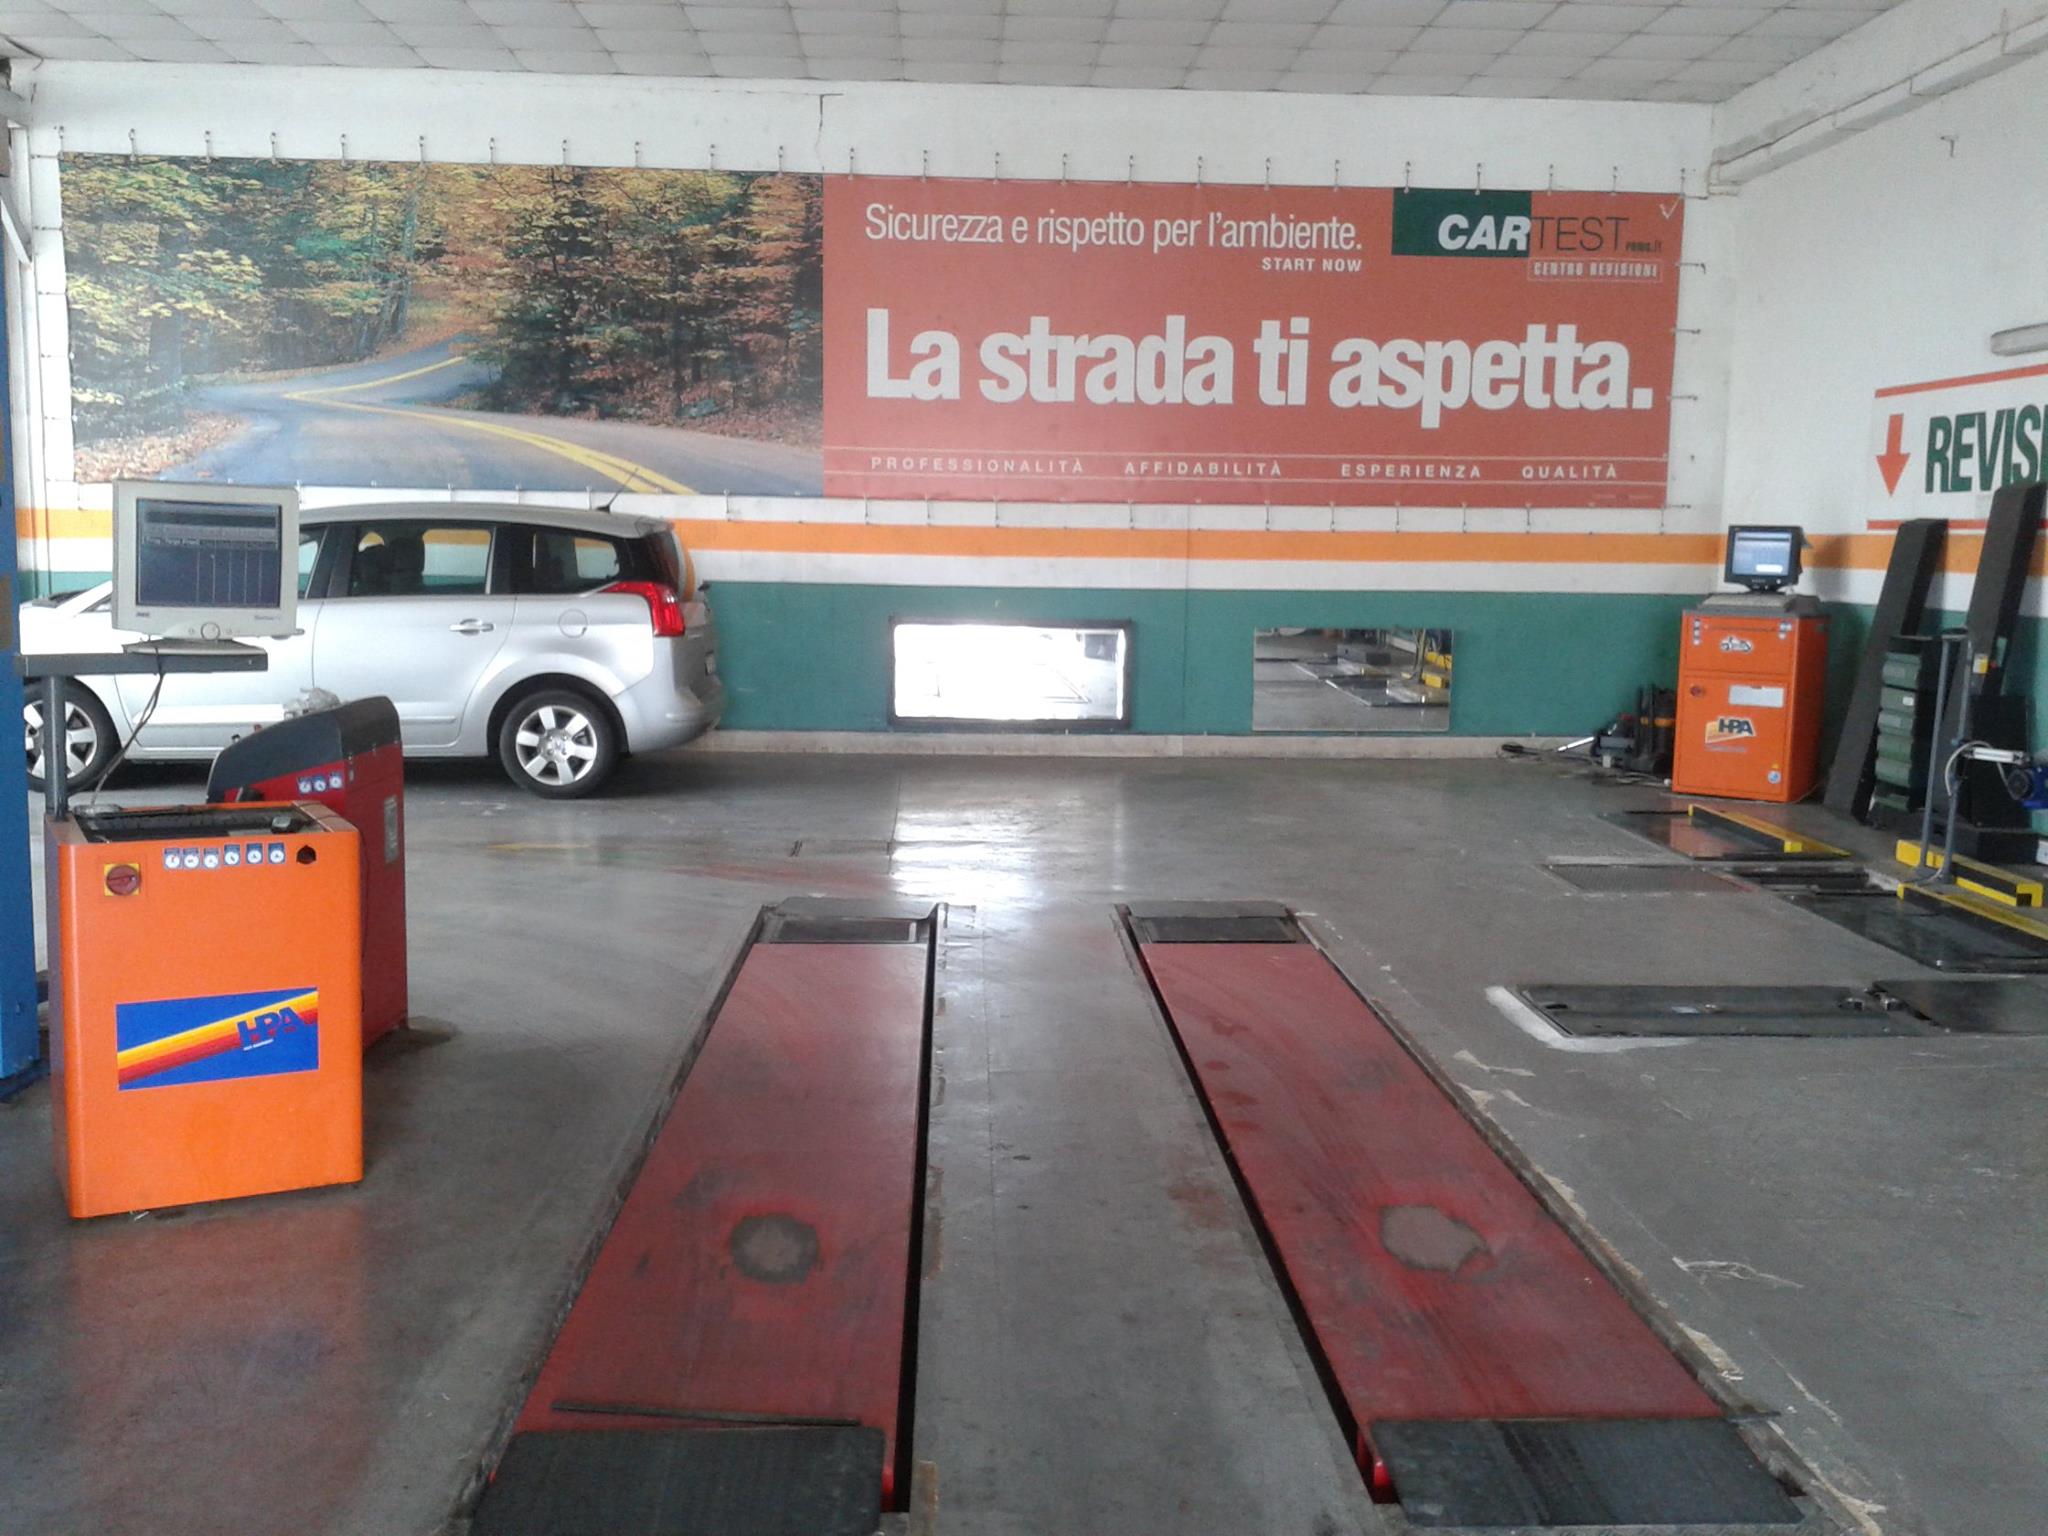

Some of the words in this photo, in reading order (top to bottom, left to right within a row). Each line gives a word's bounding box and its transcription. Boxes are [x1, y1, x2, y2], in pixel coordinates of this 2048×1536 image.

[865, 203, 1003, 244] Sicurezza
[1011, 215, 1028, 244] e
[1037, 209, 1144, 252] rispetto
[1153, 216, 1201, 254] per
[1208, 212, 1363, 251] l'ambiente.
[1262, 257, 1315, 272] START
[1322, 258, 1363, 273] NOW
[1533, 261, 1584, 277] CENTRO
[1589, 261, 1658, 278] REVISIONI
[866, 308, 961, 400] La
[978, 314, 1235, 406] strada
[1253, 316, 1310, 407] ti
[1329, 323, 1654, 430] aspetta.
[870, 456, 1084, 473] PROFESSIONALITÀ
[1124, 460, 1282, 477] AFFIDABILITÀ
[1340, 463, 1481, 479] ESPERIENZA
[1521, 462, 1618, 480] QUALITÀ
[1717, 717, 1755, 737] HPA
